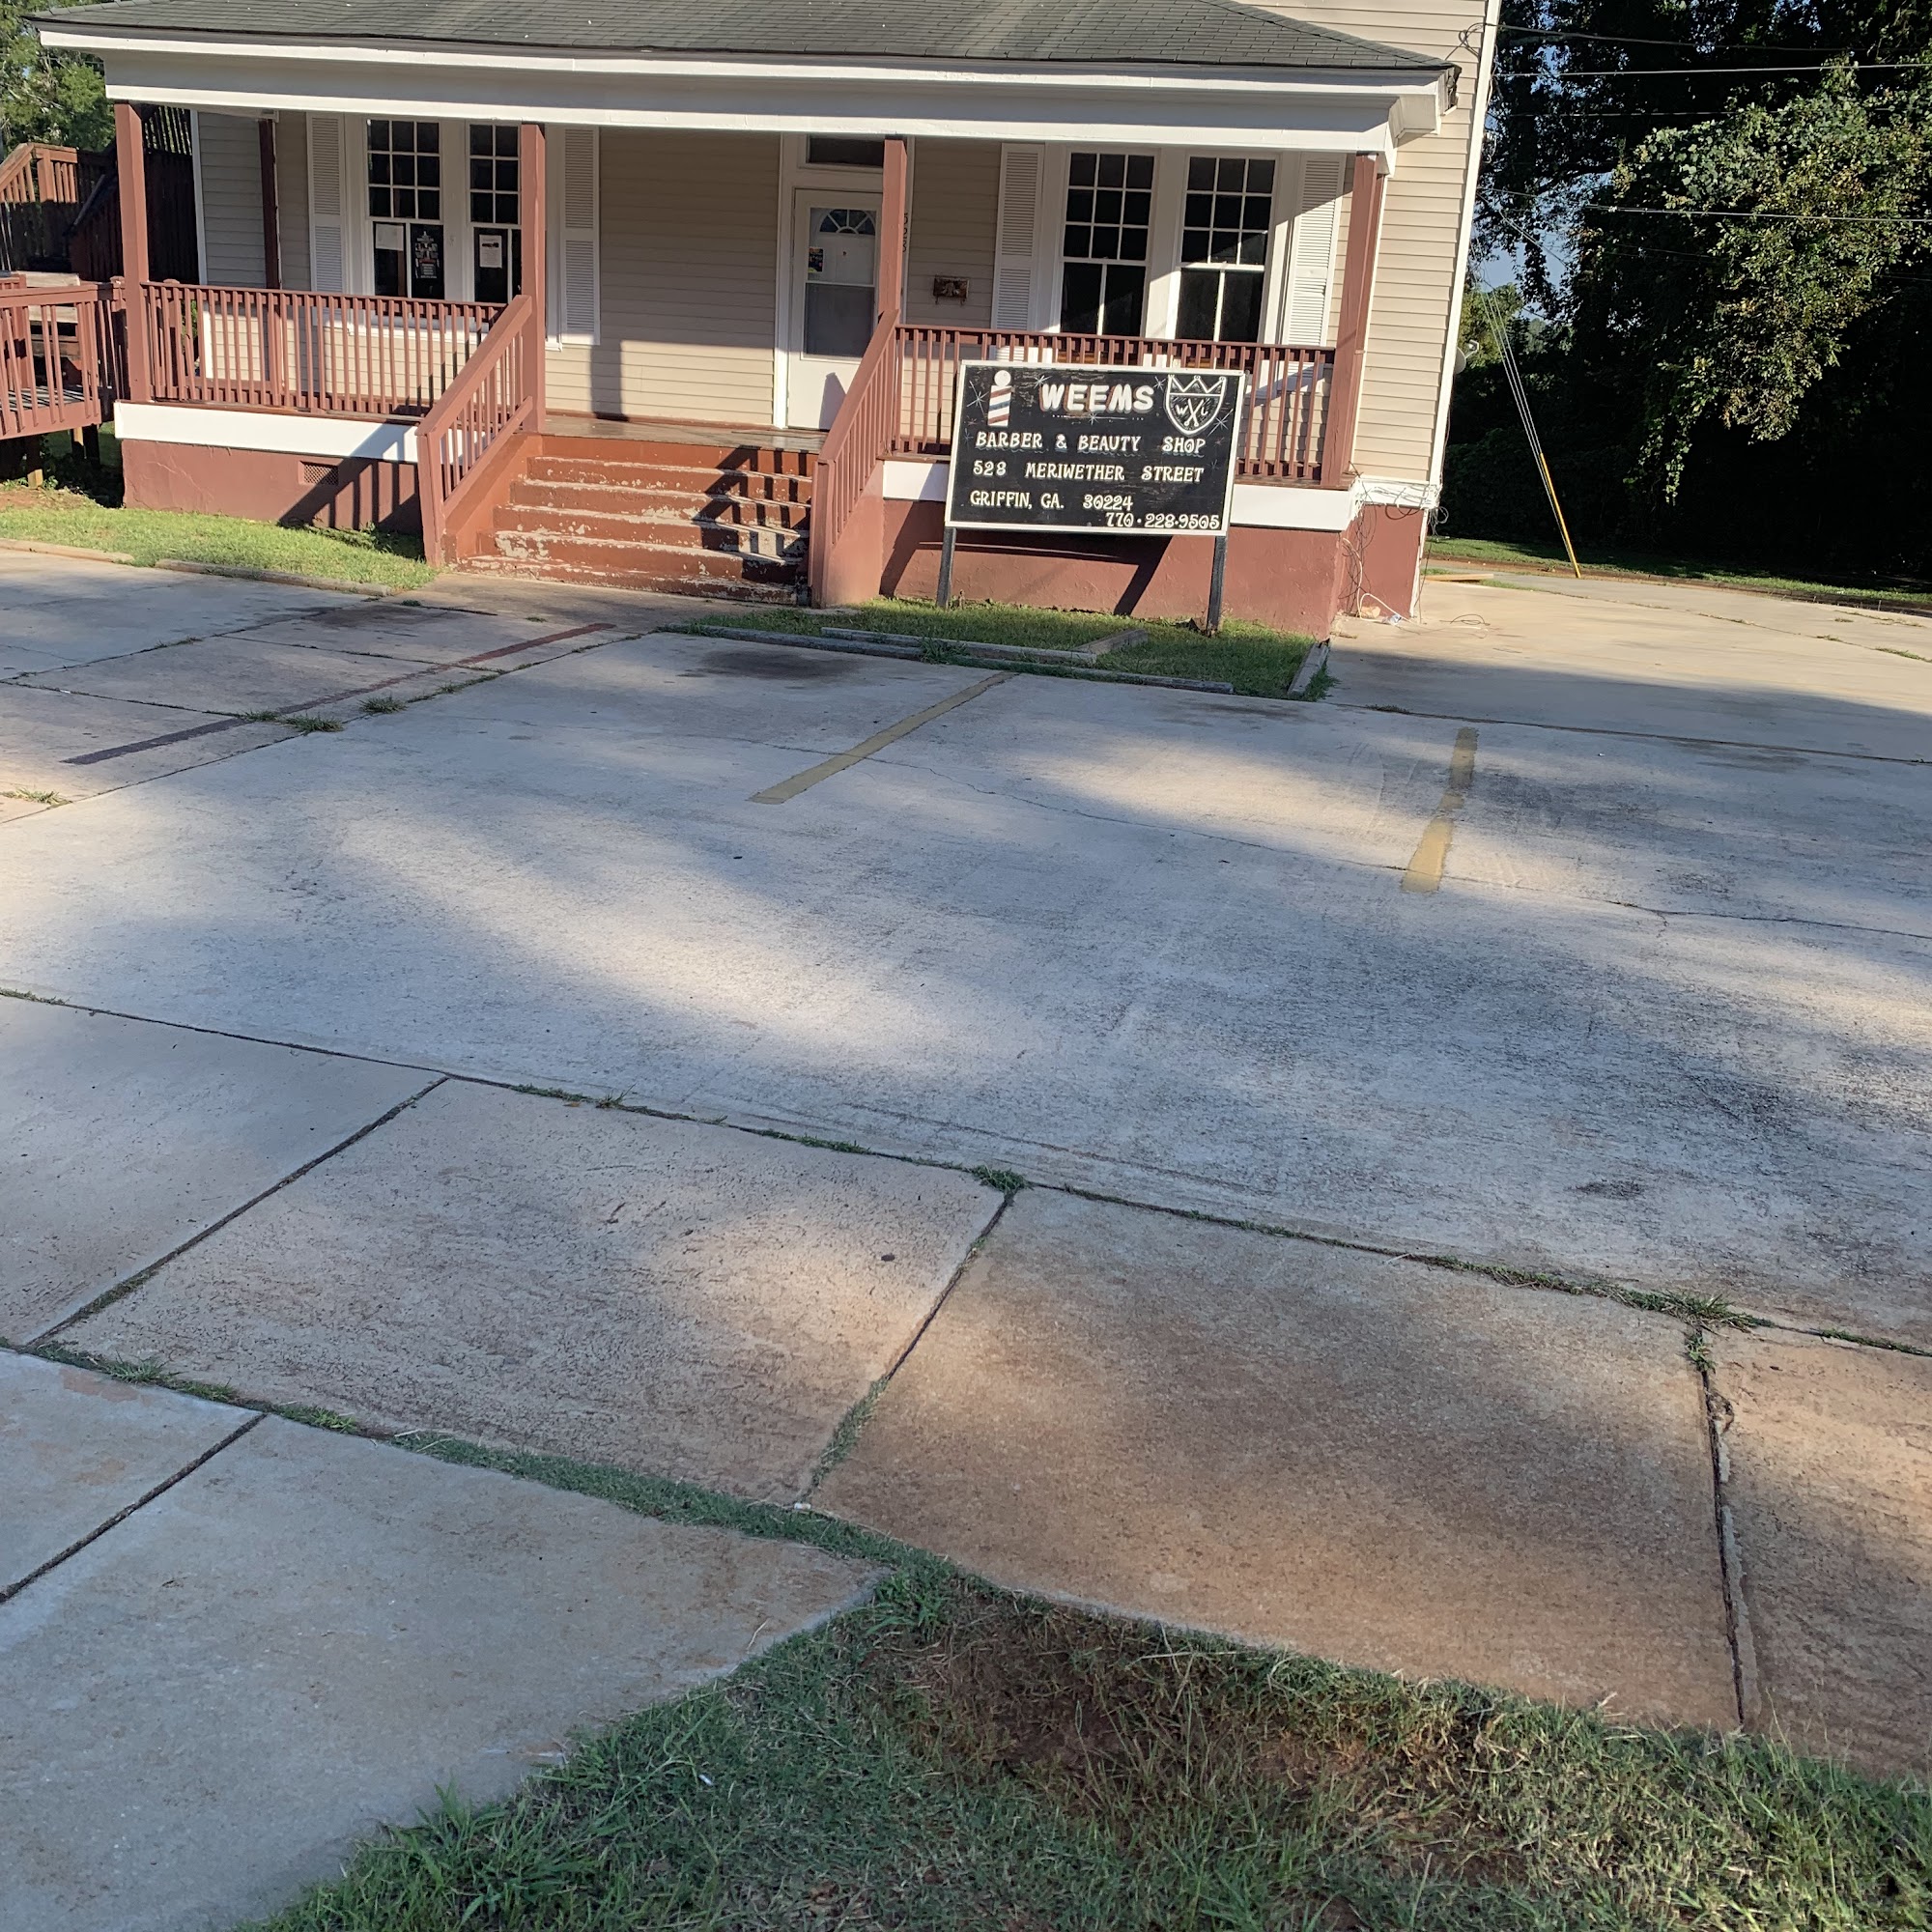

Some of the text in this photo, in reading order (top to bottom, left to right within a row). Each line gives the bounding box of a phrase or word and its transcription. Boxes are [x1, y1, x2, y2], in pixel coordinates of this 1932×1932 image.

[1039, 384, 1155, 413] WEEMS
[975, 431, 1207, 454] BARBER & BEAUTY SHOP
[973, 460, 1205, 482] 528 MERIWETHER STREET
[970, 491, 1134, 511] GRIFFIN, GA. 30224
